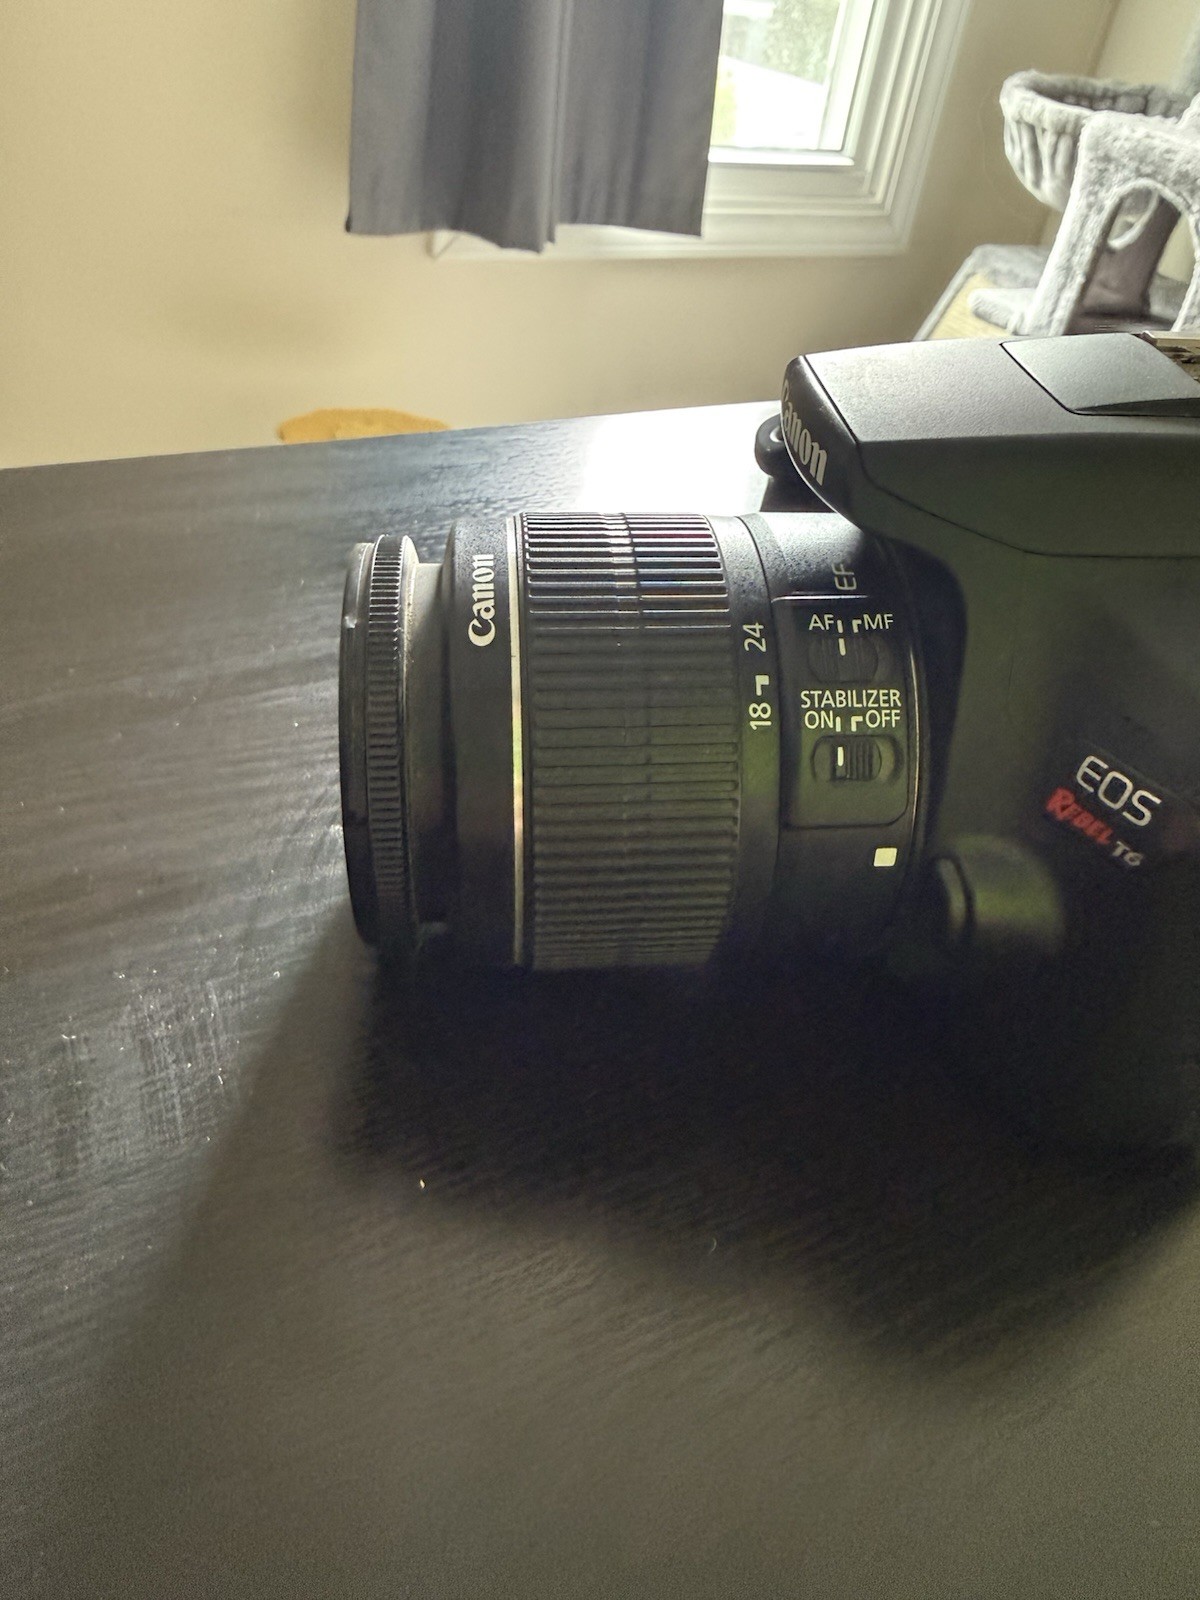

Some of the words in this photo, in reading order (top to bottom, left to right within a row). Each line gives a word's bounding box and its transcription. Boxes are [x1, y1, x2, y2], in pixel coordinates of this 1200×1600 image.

[468, 553, 496, 647] Canon
[809, 613, 834, 630] AF
[863, 613, 894, 630] MF
[744, 622, 767, 653] 24
[800, 689, 902, 709] STABILIZER
[749, 702, 772, 731] 18
[803, 711, 834, 730] ON
[865, 709, 901, 728] OFF
[1076, 755, 1162, 827] EOS
[1112, 840, 1145, 867] T6
